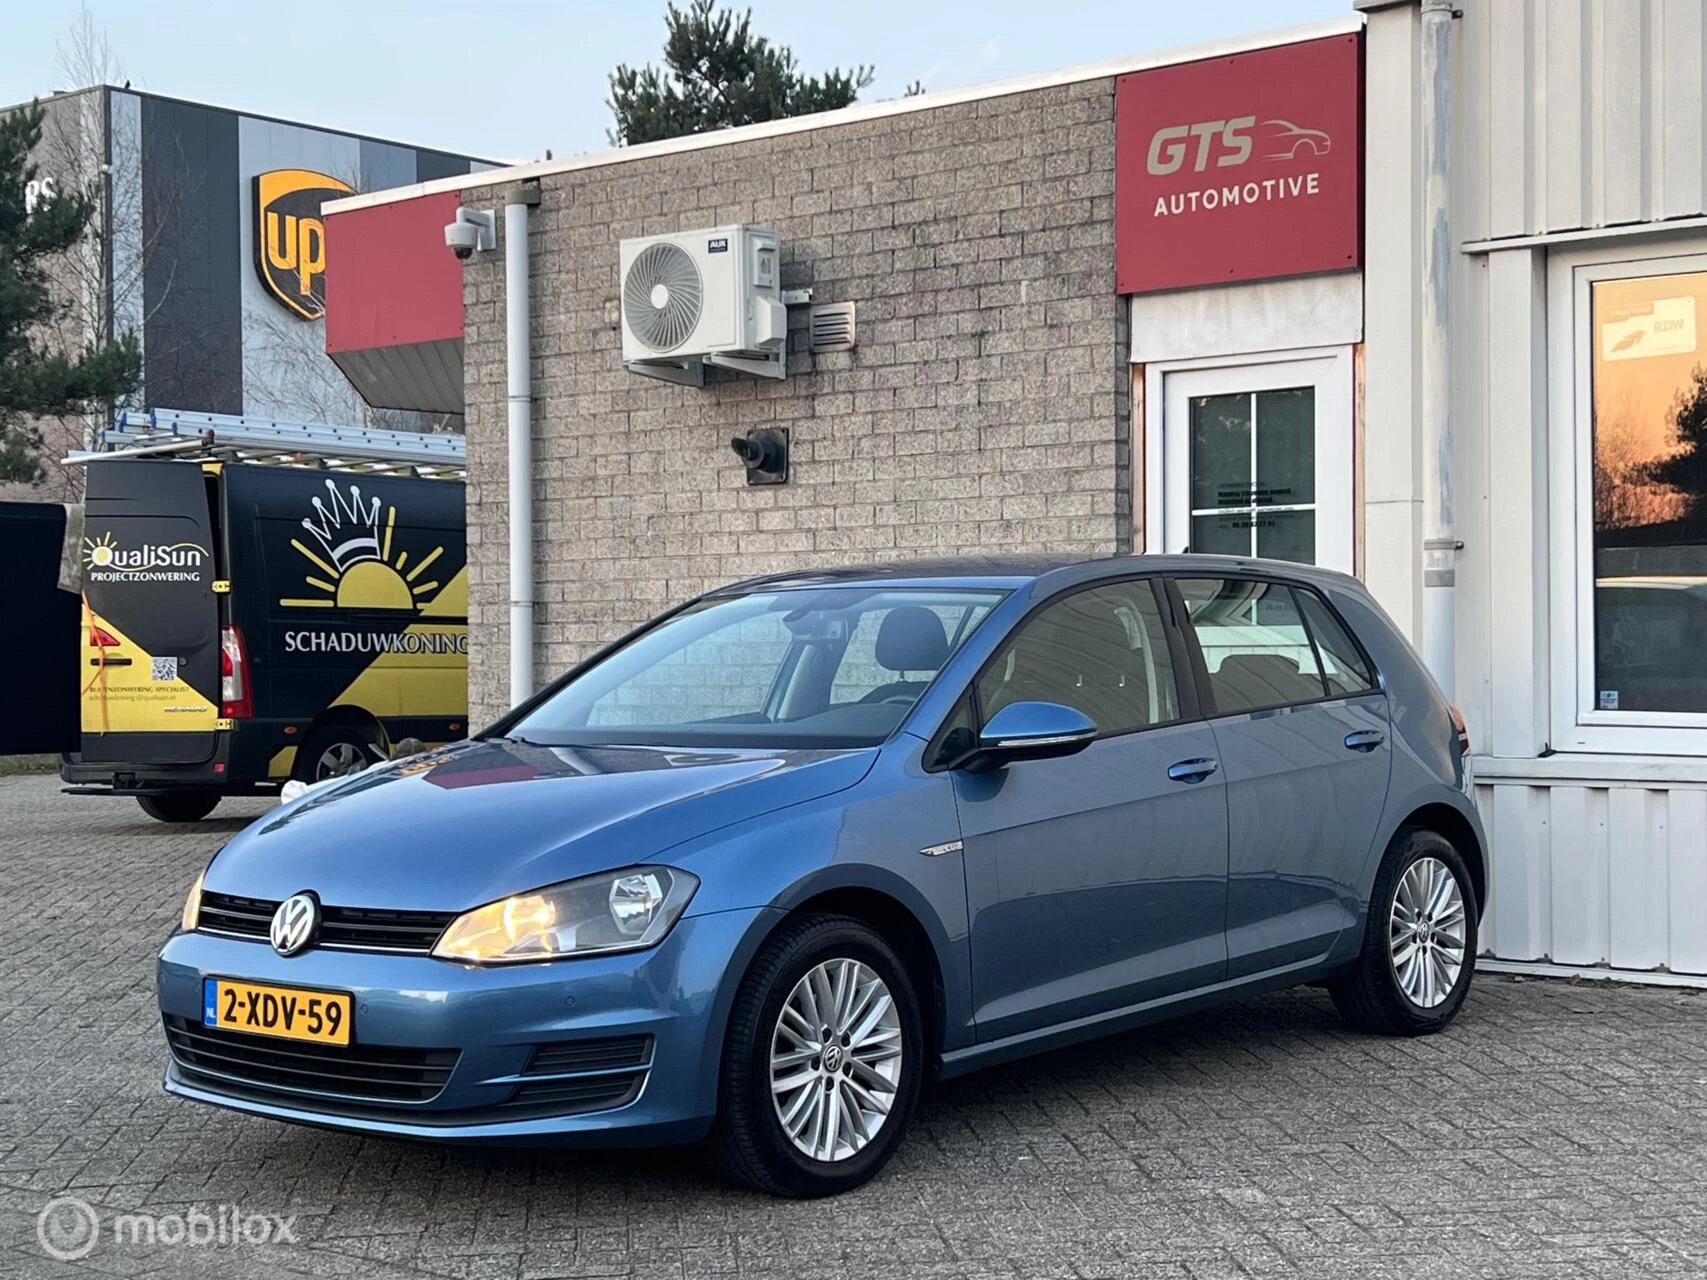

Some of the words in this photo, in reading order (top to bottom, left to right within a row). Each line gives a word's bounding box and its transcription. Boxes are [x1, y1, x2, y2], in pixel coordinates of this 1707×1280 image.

[1147, 116, 1256, 175] GTS
[1154, 173, 1320, 217] AUTOMOTIVE
[1654, 318, 1685, 333] RDW
[91, 544, 201, 571] QualiSun
[91, 572, 200, 582] PROJECTZONWERING
[206, 1007, 216, 1019] NL
[224, 988, 342, 1036] 2-XDV-59
